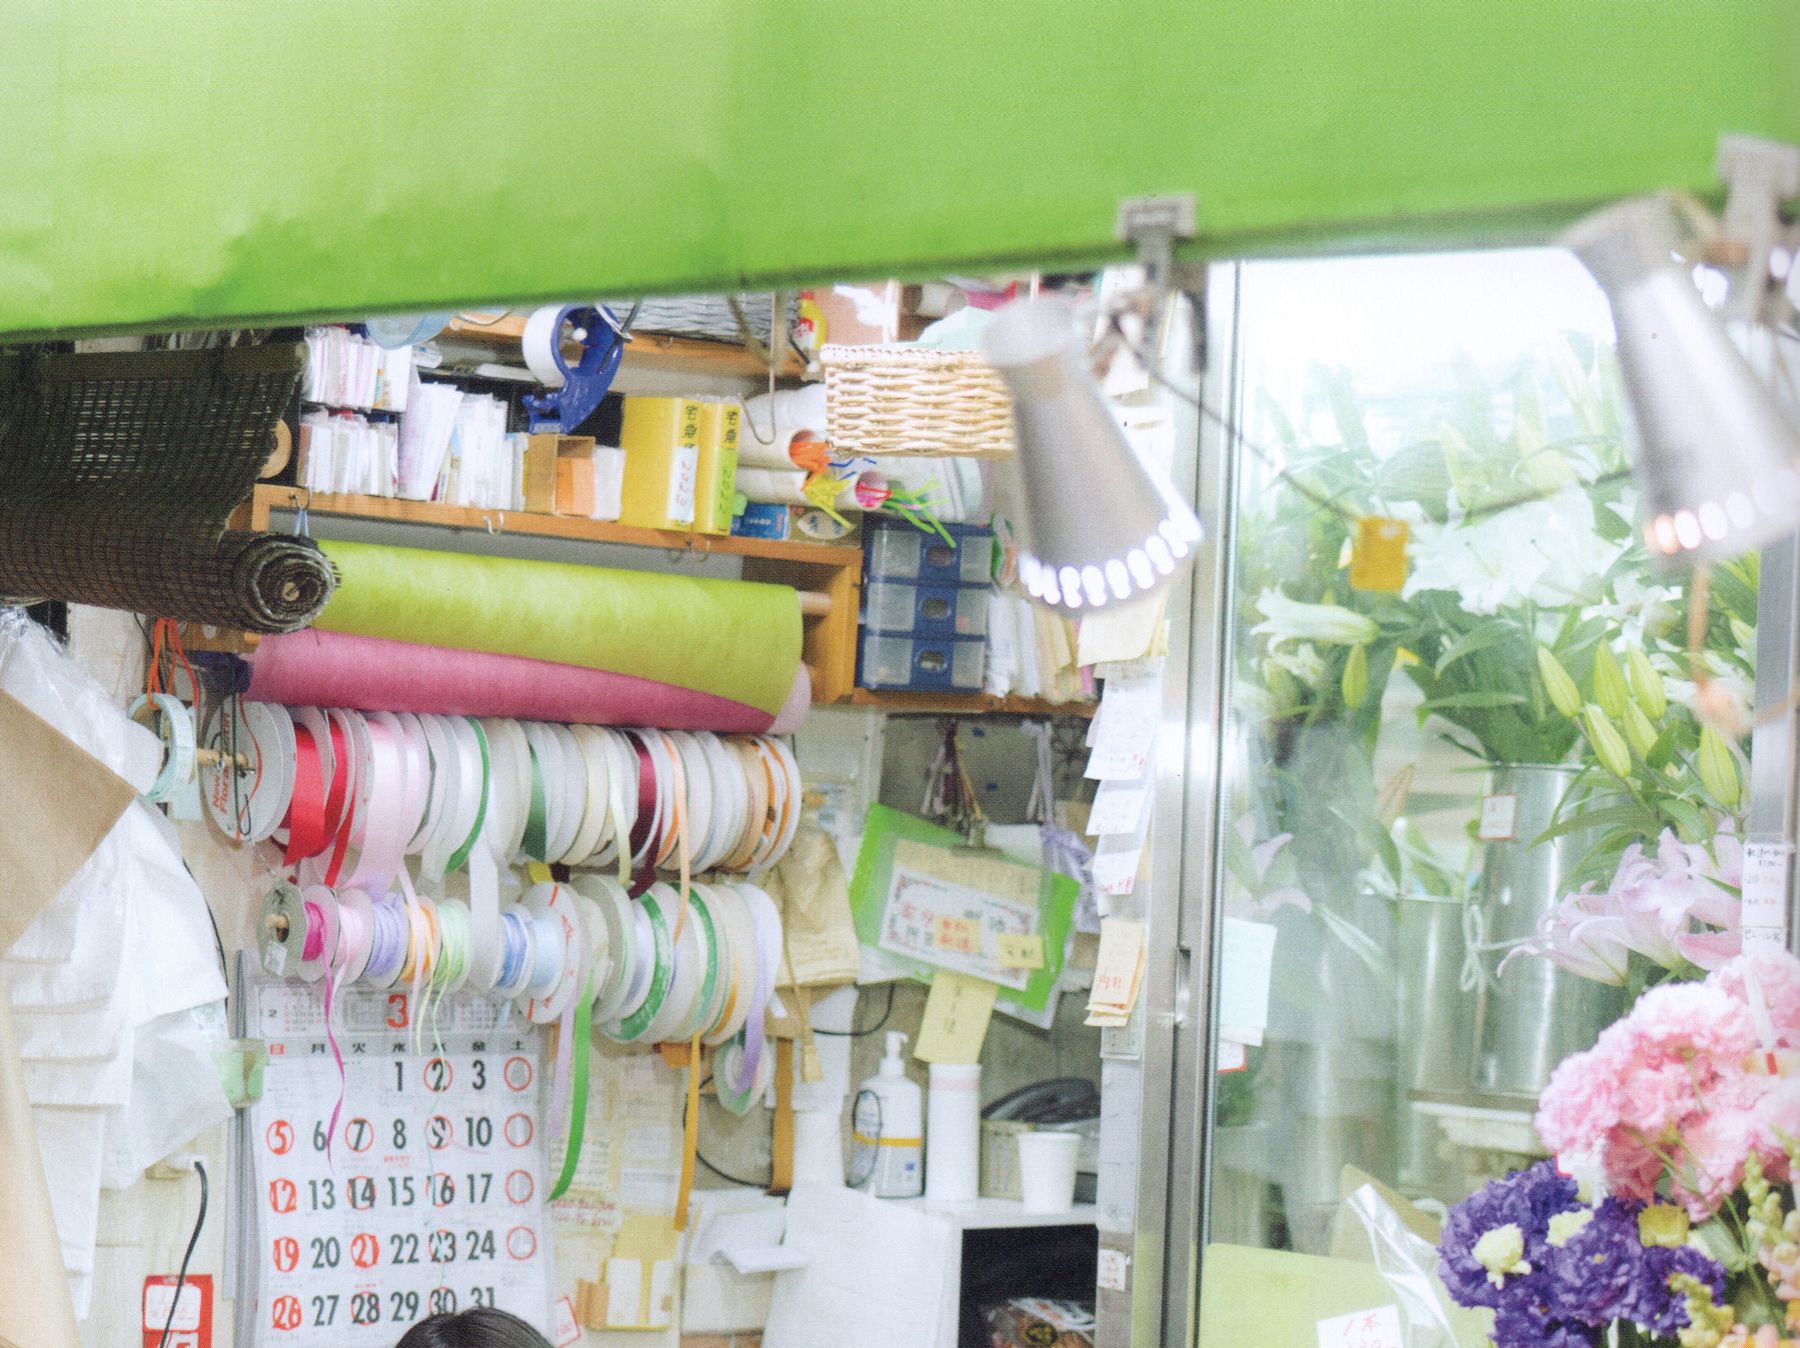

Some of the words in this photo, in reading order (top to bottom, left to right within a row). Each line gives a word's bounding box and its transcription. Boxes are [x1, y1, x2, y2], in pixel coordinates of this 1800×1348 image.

[386, 992, 409, 1029] 3
[269, 1043, 285, 1055] 日
[311, 1043, 325, 1054] 月
[352, 1042, 366, 1054] 火
[392, 1041, 406, 1053] 水
[471, 1041, 487, 1053] 金
[511, 1040, 526, 1051] 土
[394, 1061, 404, 1091] 1
[431, 1060, 447, 1092] 2
[471, 1060, 487, 1090] 3
[273, 1120, 288, 1155] 5
[313, 1121, 327, 1151] 6
[352, 1120, 367, 1150] 7
[393, 1119, 407, 1150] 8
[465, 1117, 492, 1147] 10
[269, 1179, 297, 1213] 12
[308, 1179, 336, 1210] 13
[347, 1177, 377, 1209] 14
[388, 1176, 415, 1206] 15
[426, 1175, 455, 1205] 16
[467, 1174, 493, 1204] 17
[273, 1237, 299, 1272] 19
[311, 1237, 341, 1269] 20
[351, 1233, 379, 1268] 21
[391, 1233, 419, 1264] 22
[429, 1232, 456, 1263] 23
[466, 1230, 495, 1260] 24
[272, 1295, 302, 1331] 26
[312, 1295, 340, 1327] 27
[351, 1293, 380, 1325] 28
[391, 1291, 419, 1322] 29
[429, 1289, 456, 1315] 30
